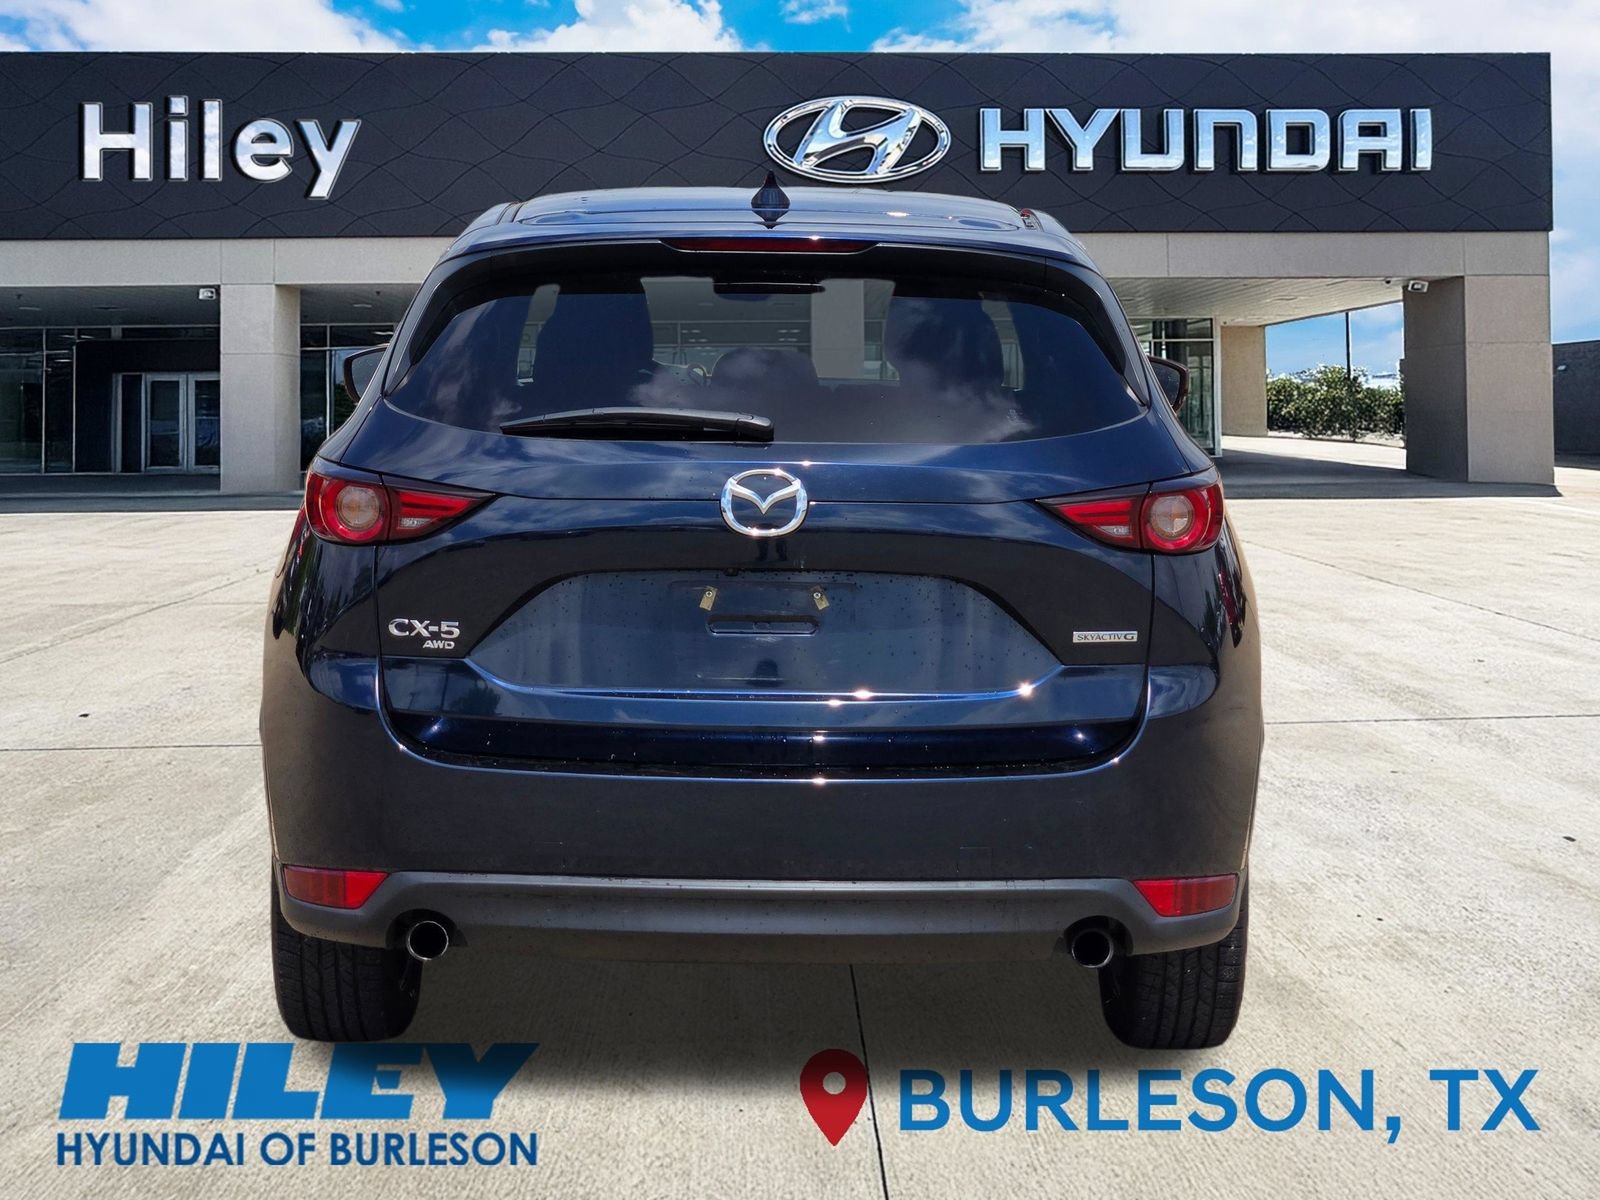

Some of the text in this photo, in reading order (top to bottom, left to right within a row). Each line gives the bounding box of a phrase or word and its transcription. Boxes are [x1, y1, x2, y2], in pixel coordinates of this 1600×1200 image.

[82, 95, 361, 200] Hiley
[979, 108, 1433, 172] HYUNDAI
[388, 618, 460, 639] CX-5
[422, 640, 456, 649] AWD
